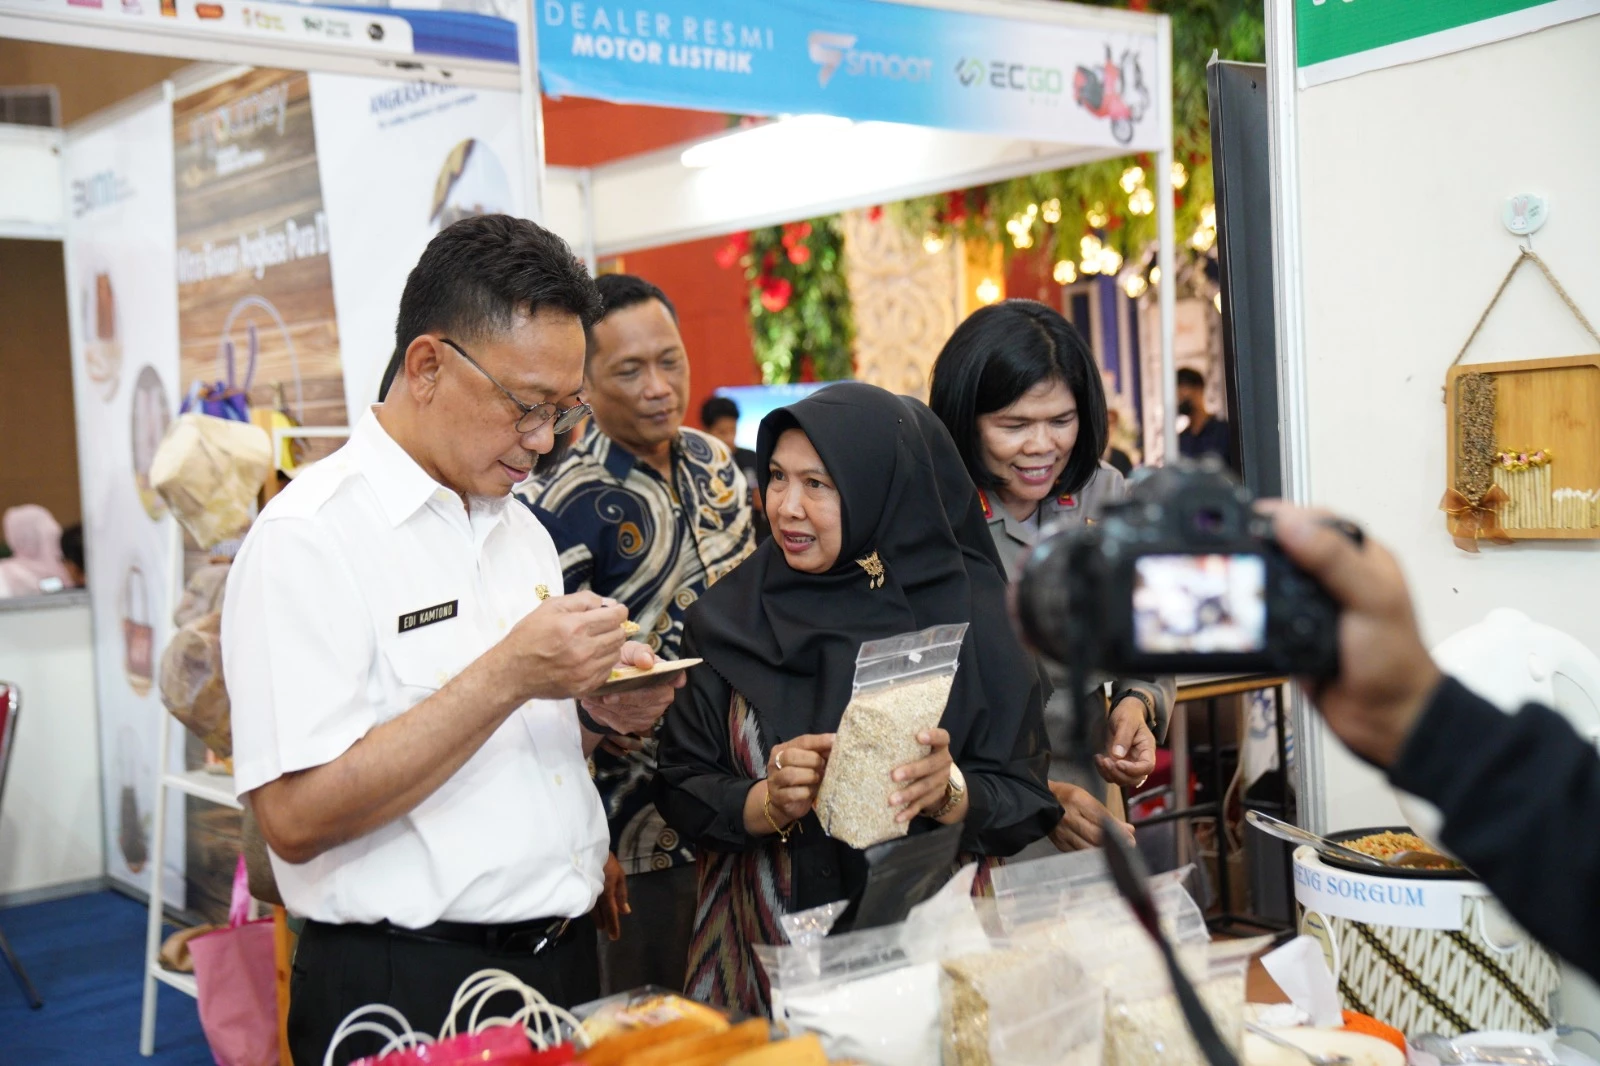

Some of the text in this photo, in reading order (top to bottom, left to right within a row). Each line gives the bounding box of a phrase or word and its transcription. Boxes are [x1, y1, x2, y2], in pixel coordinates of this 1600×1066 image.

[544, 0, 775, 50] DEALER RESMI
[571, 32, 754, 74] MOTOR LISTRIK
[989, 60, 1064, 94] ECGO
[285, 218, 315, 261] Pura
[403, 604, 453, 629] EDI KAMTONO
[1326, 877, 1426, 908] SORGUM
